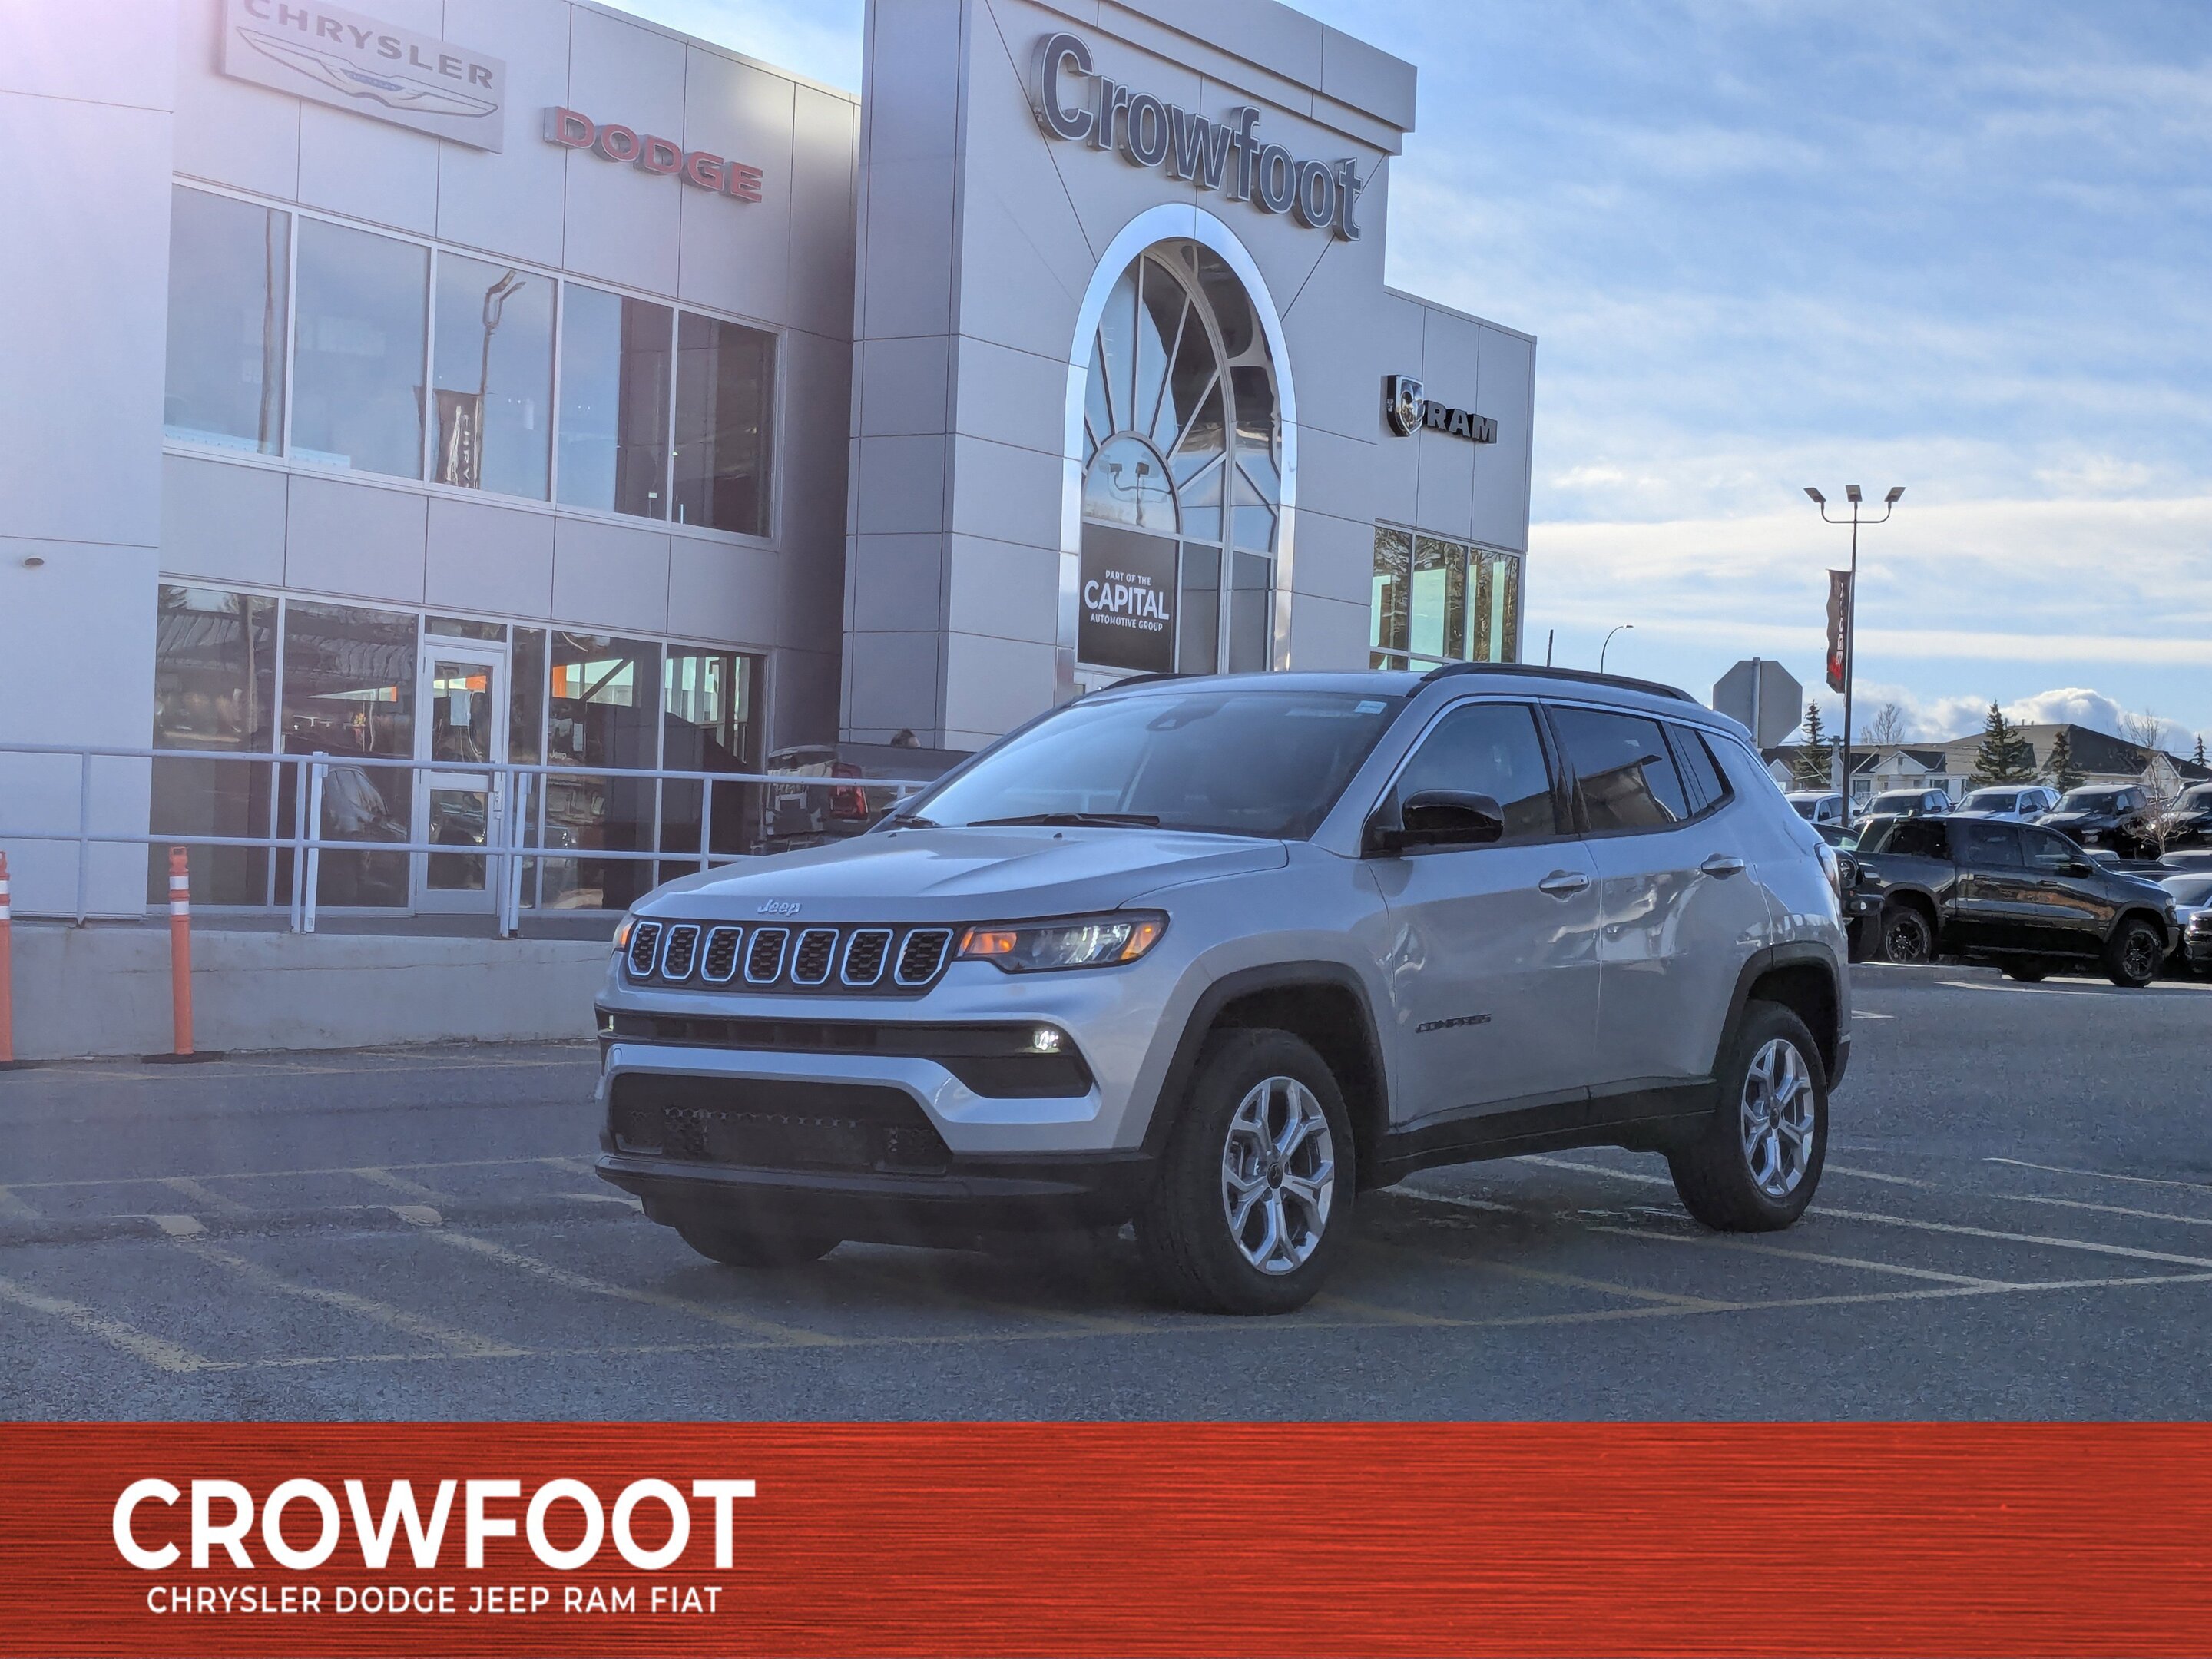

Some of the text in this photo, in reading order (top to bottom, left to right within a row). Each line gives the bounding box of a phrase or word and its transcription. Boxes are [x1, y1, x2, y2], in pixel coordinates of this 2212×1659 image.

[244, 0, 493, 89] CHRYSLER
[547, 106, 763, 203] DODGE
[1034, 31, 1362, 241] Crowfoot
[1424, 399, 1498, 444] RAM
[1105, 569, 1152, 586] PART OF THE
[1084, 580, 1171, 621] CAPITAL
[1090, 613, 1164, 632] AUTOMOTIVE GROUP
[757, 899, 801, 917] Jeep
